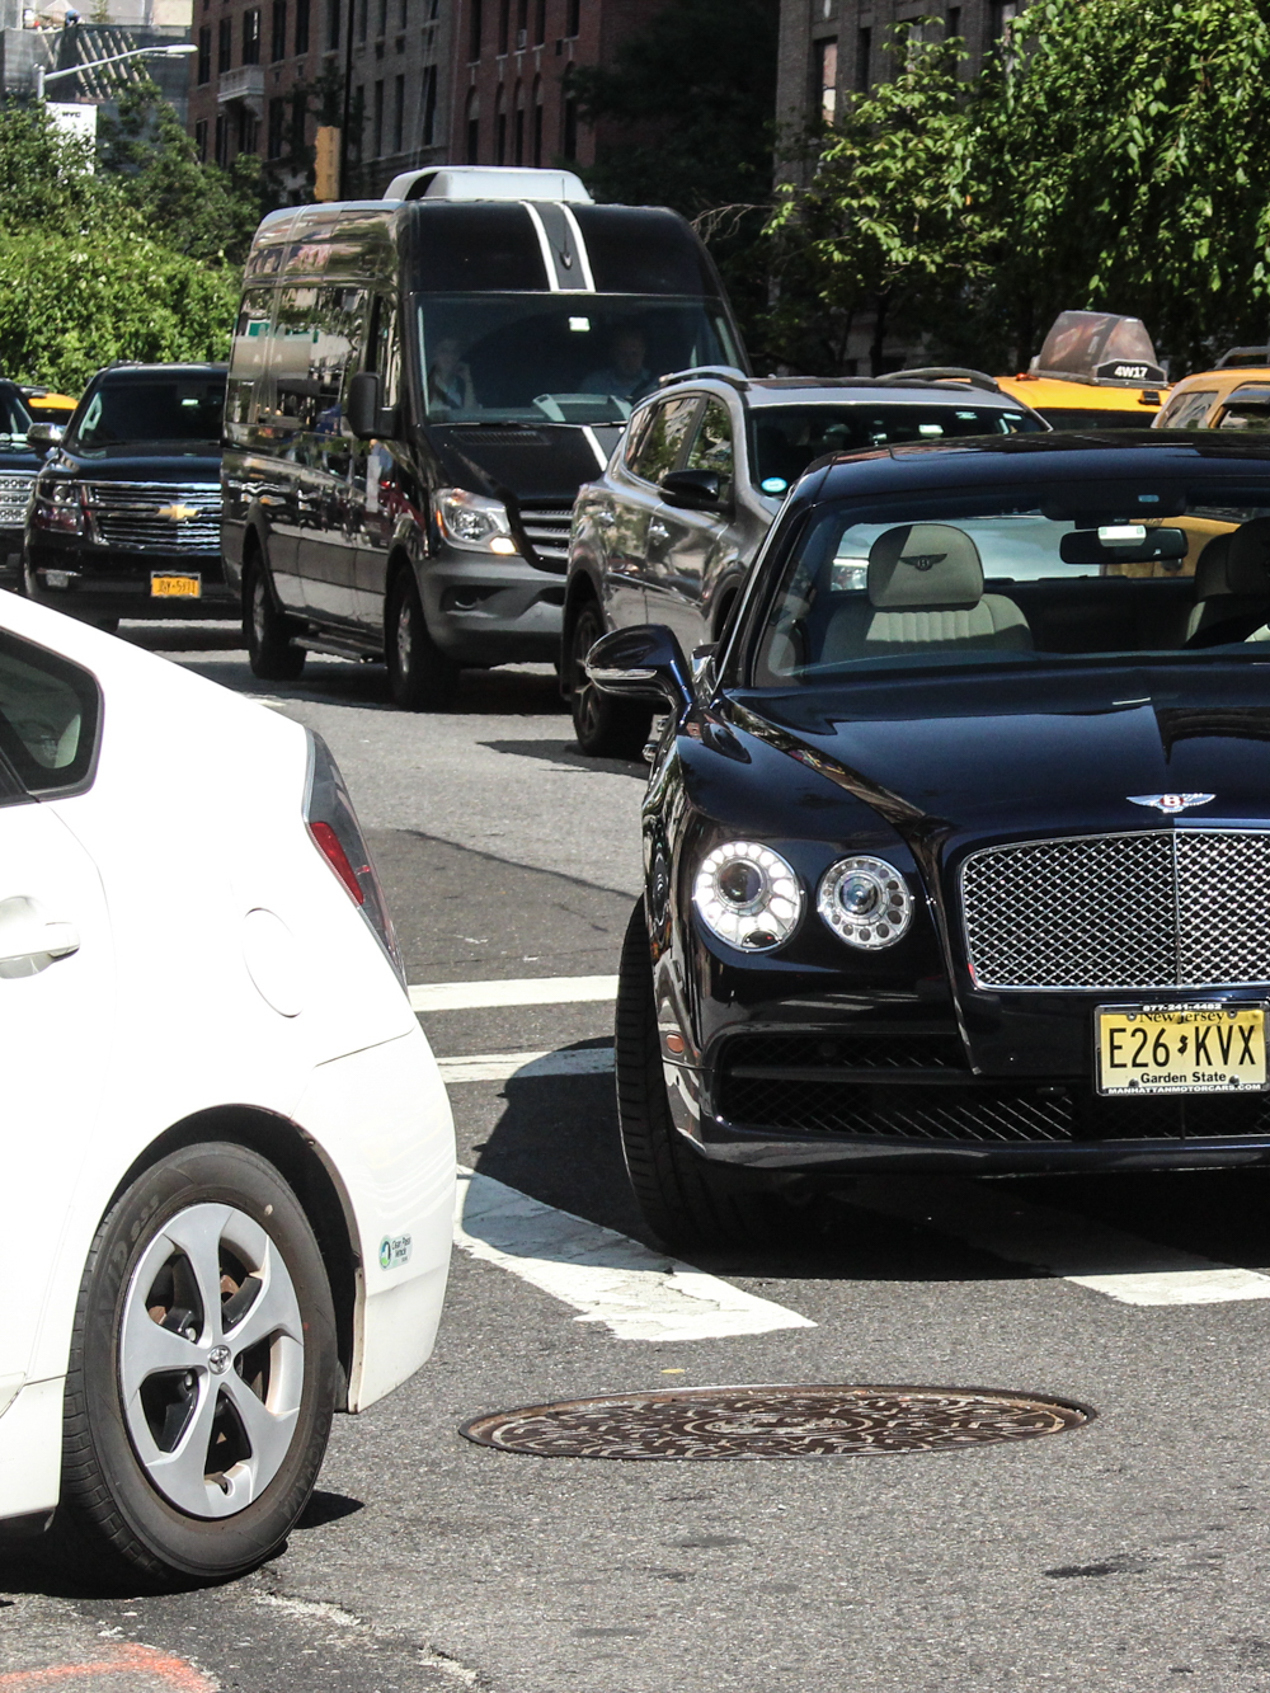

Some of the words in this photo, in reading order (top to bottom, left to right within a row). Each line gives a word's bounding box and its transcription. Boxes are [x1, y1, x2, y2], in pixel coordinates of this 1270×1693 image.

[1114, 366, 1148, 378] 4W17
[1139, 1012, 1174, 1023] New
[1140, 1072, 1187, 1084] Garden
[1192, 1071, 1226, 1082] State
[1108, 1084, 1261, 1095] MANHATTANMOTORCARS.COM
